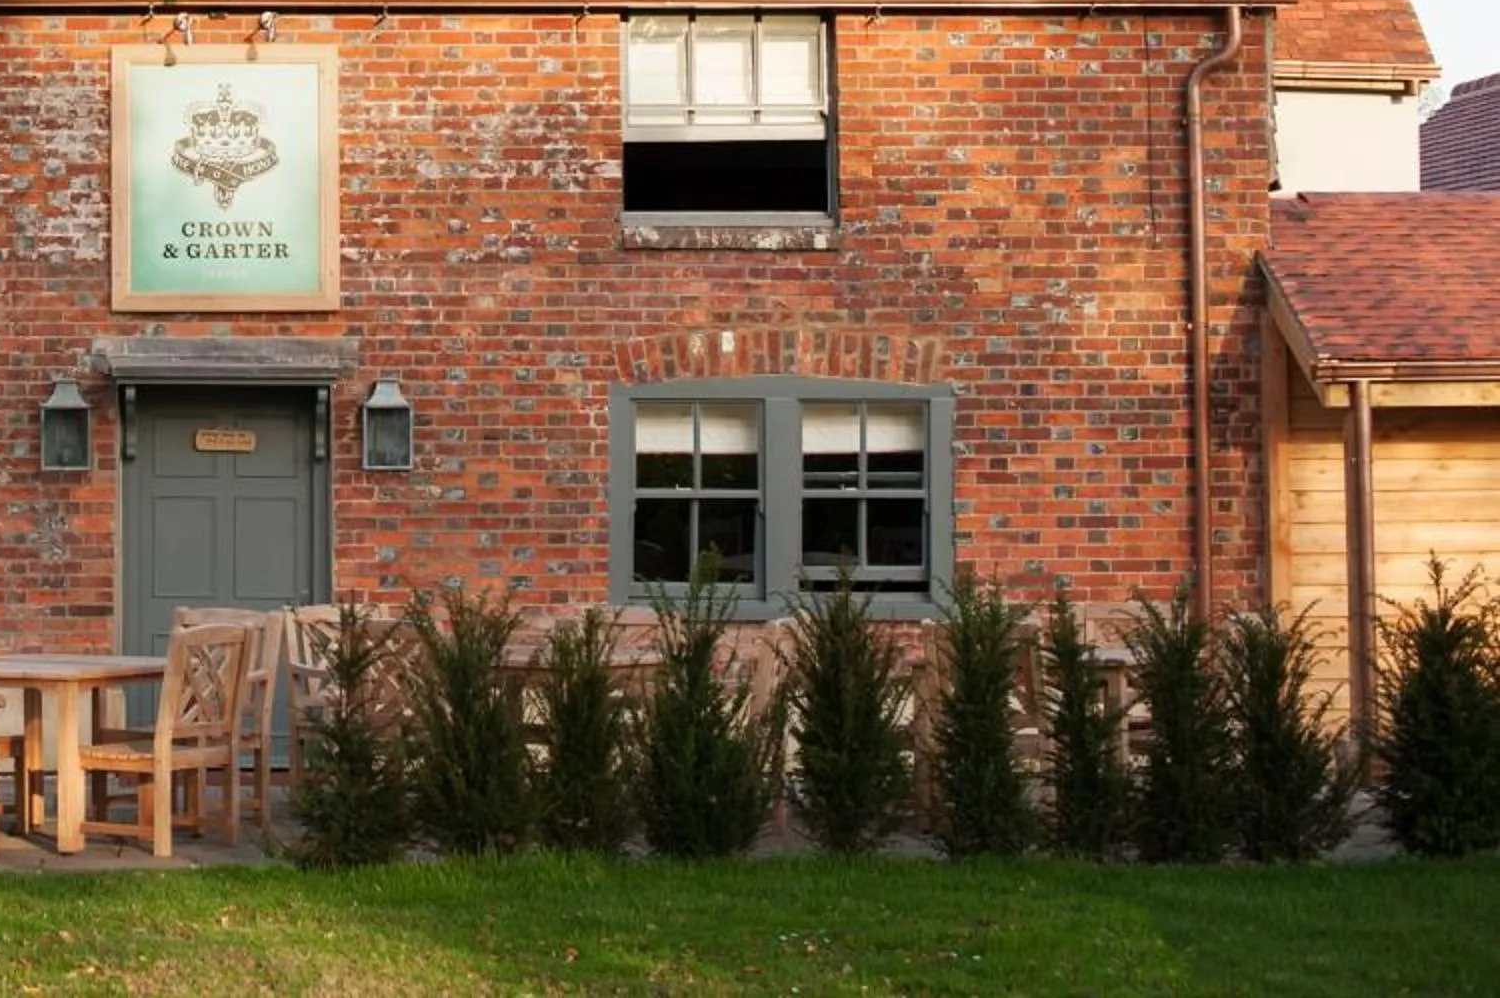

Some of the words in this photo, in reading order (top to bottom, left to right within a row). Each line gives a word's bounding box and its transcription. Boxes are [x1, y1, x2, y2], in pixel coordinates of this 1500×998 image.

[181, 221, 273, 238] CROWN
[163, 243, 179, 259] &
[186, 243, 289, 259] GARTER
